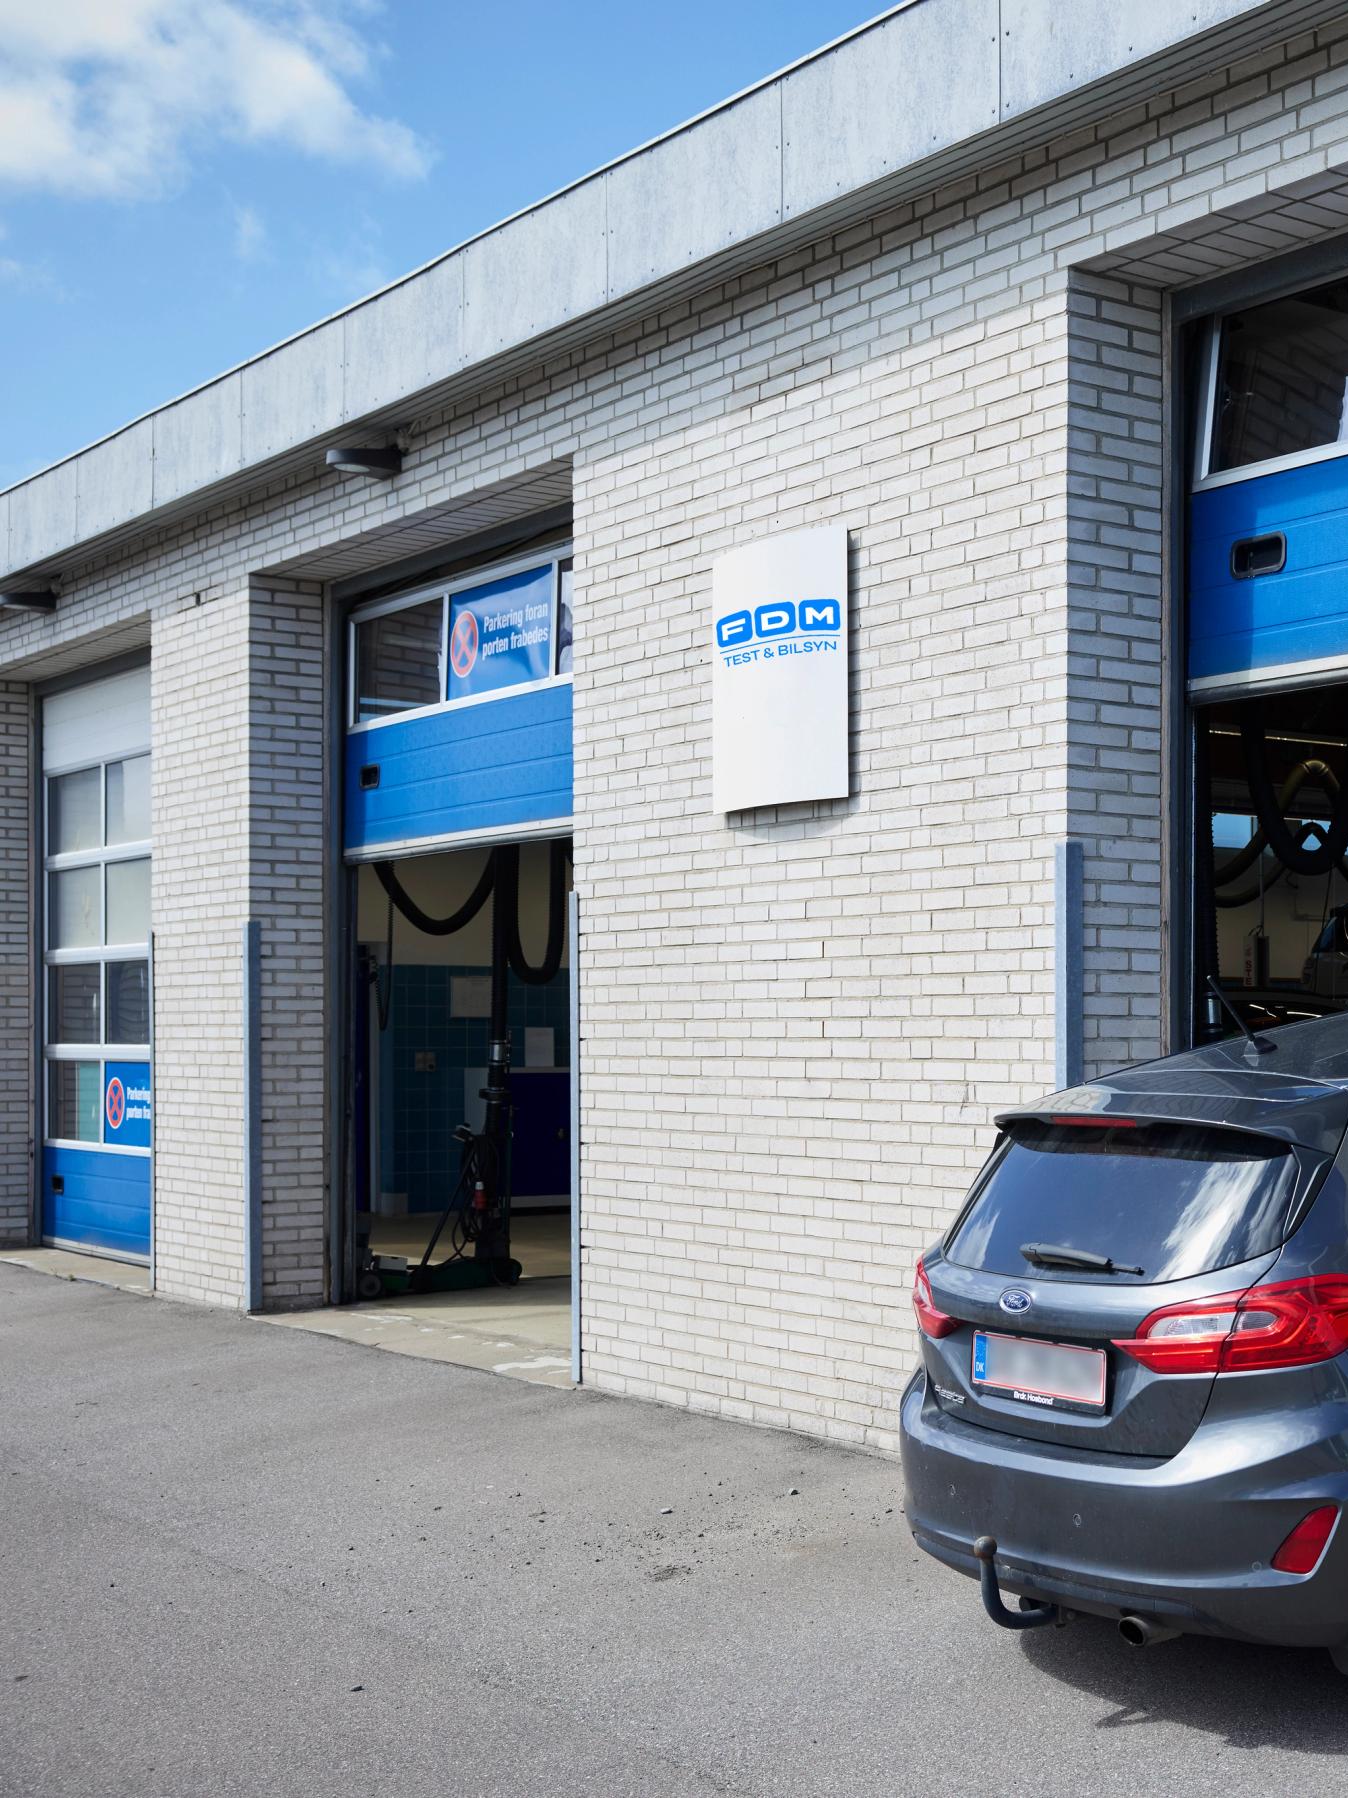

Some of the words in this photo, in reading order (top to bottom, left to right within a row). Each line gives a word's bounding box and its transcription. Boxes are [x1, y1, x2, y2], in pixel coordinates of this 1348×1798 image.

[483, 608, 523, 633] Parkering
[525, 603, 548, 621] foran
[720, 604, 835, 643] FDM
[482, 636, 508, 661] porten
[510, 626, 549, 649] frabedes
[723, 649, 760, 667] TEST
[763, 647, 774, 658] &
[778, 640, 837, 656] BILSYN
[975, 1361, 985, 1373] DK
